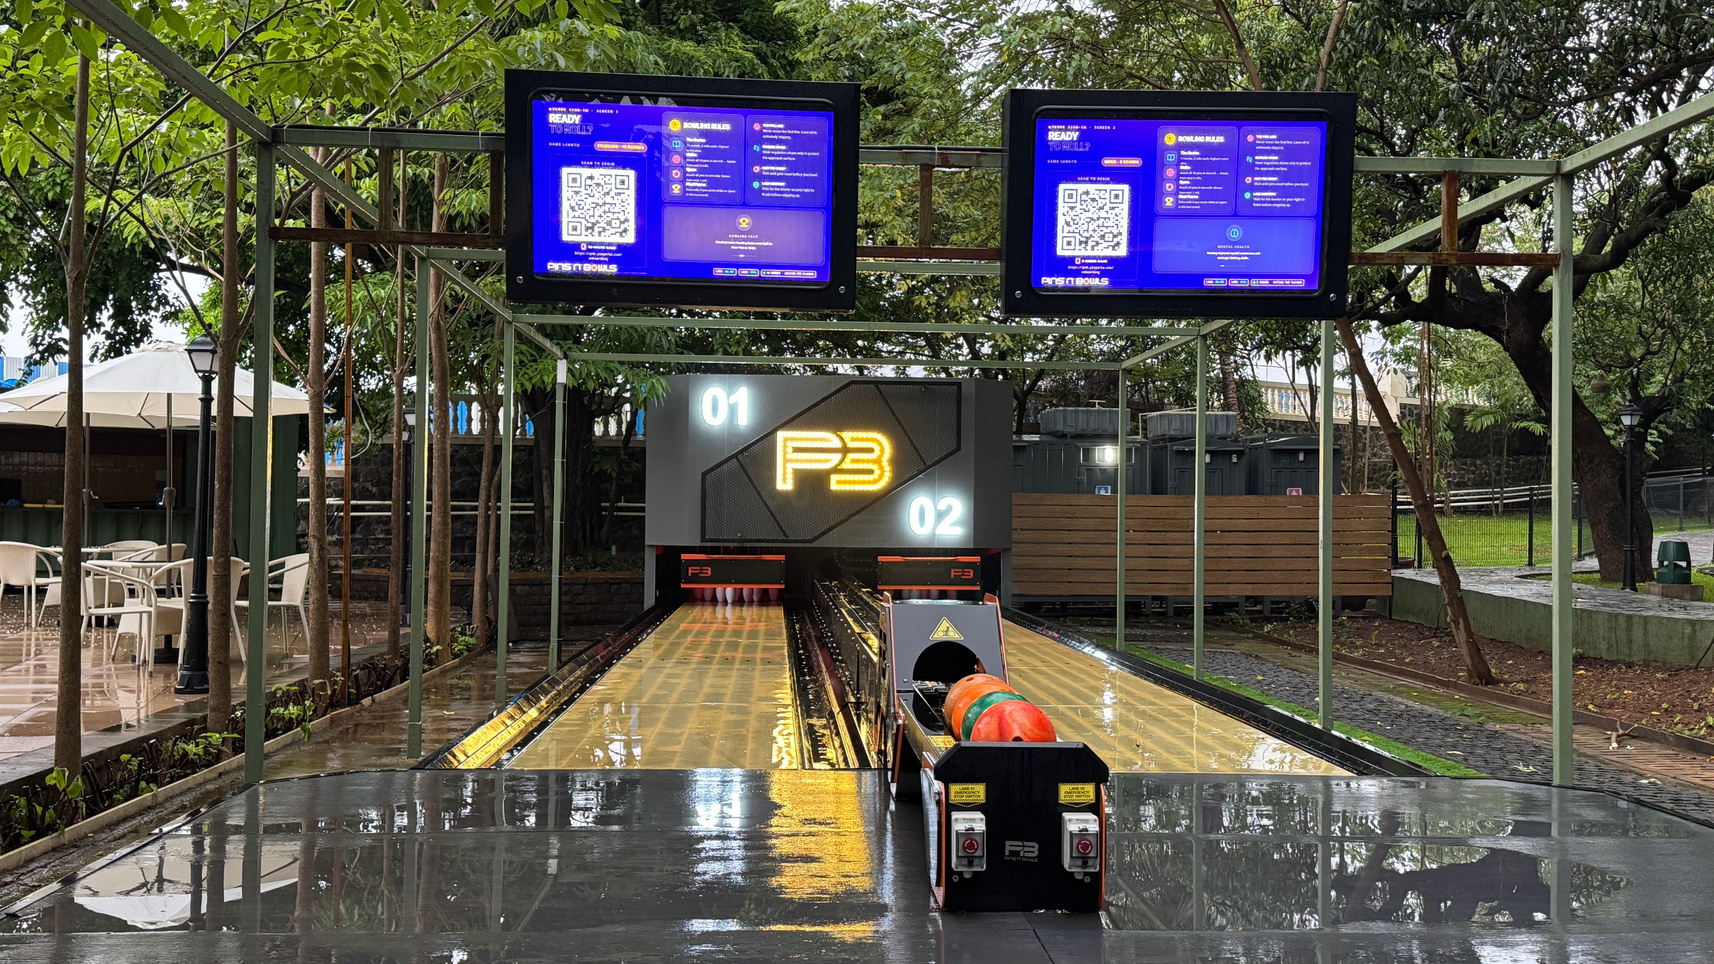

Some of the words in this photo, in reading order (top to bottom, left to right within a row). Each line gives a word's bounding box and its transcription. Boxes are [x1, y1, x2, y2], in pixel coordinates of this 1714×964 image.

[548, 113, 581, 123] READY
[549, 124, 563, 134] TO
[564, 124, 593, 134] ROLL?
[1048, 131, 1079, 140] READY
[1048, 142, 1061, 151] TO
[1062, 142, 1091, 151] ROLL?
[583, 264, 618, 272] BOWLS
[701, 386, 748, 426] 01
[908, 496, 962, 536] 02
